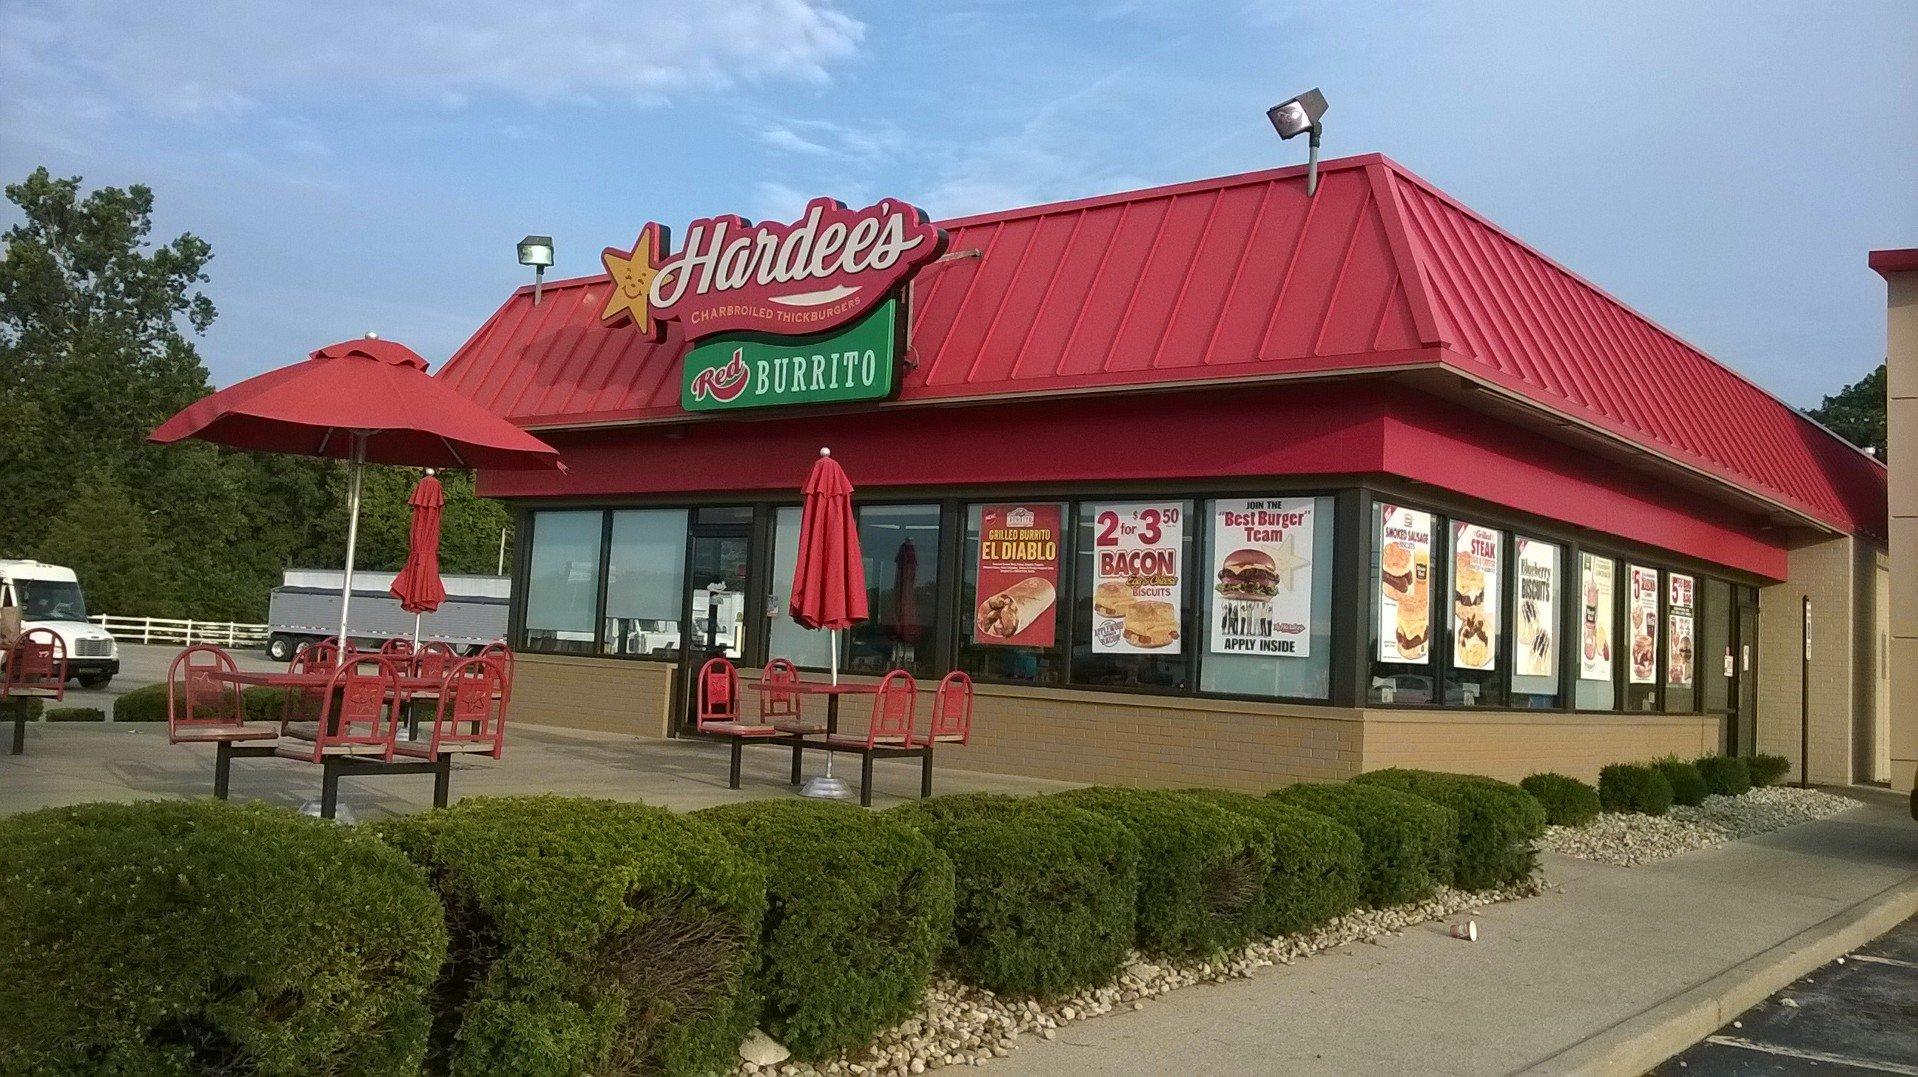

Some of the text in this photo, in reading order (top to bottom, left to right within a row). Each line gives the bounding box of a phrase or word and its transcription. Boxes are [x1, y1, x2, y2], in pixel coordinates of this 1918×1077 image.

[649, 202, 923, 309] Hardee's
[691, 296, 862, 325] CHARBROILED THICKBURGERS
[691, 347, 876, 402] Red BURRITO
[1246, 501, 1282, 510] JOIN THE
[988, 529, 1051, 541] GRILLED BURRITO
[1096, 510, 1119, 547] 2
[1120, 522, 1137, 536] for
[1244, 526, 1283, 542] Team
[1385, 526, 1429, 545] SMOKED SAUSAGE
[982, 541, 1057, 561] EL DIABLO
[1471, 538, 1496, 560] STEAK
[1099, 549, 1175, 576] BACON
[1520, 558, 1551, 583] Blueberry
[1132, 587, 1171, 597] BISCUITS
[1521, 577, 1550, 603] BISCUITS
[1223, 638, 1296, 653] APPLY INSIDE
